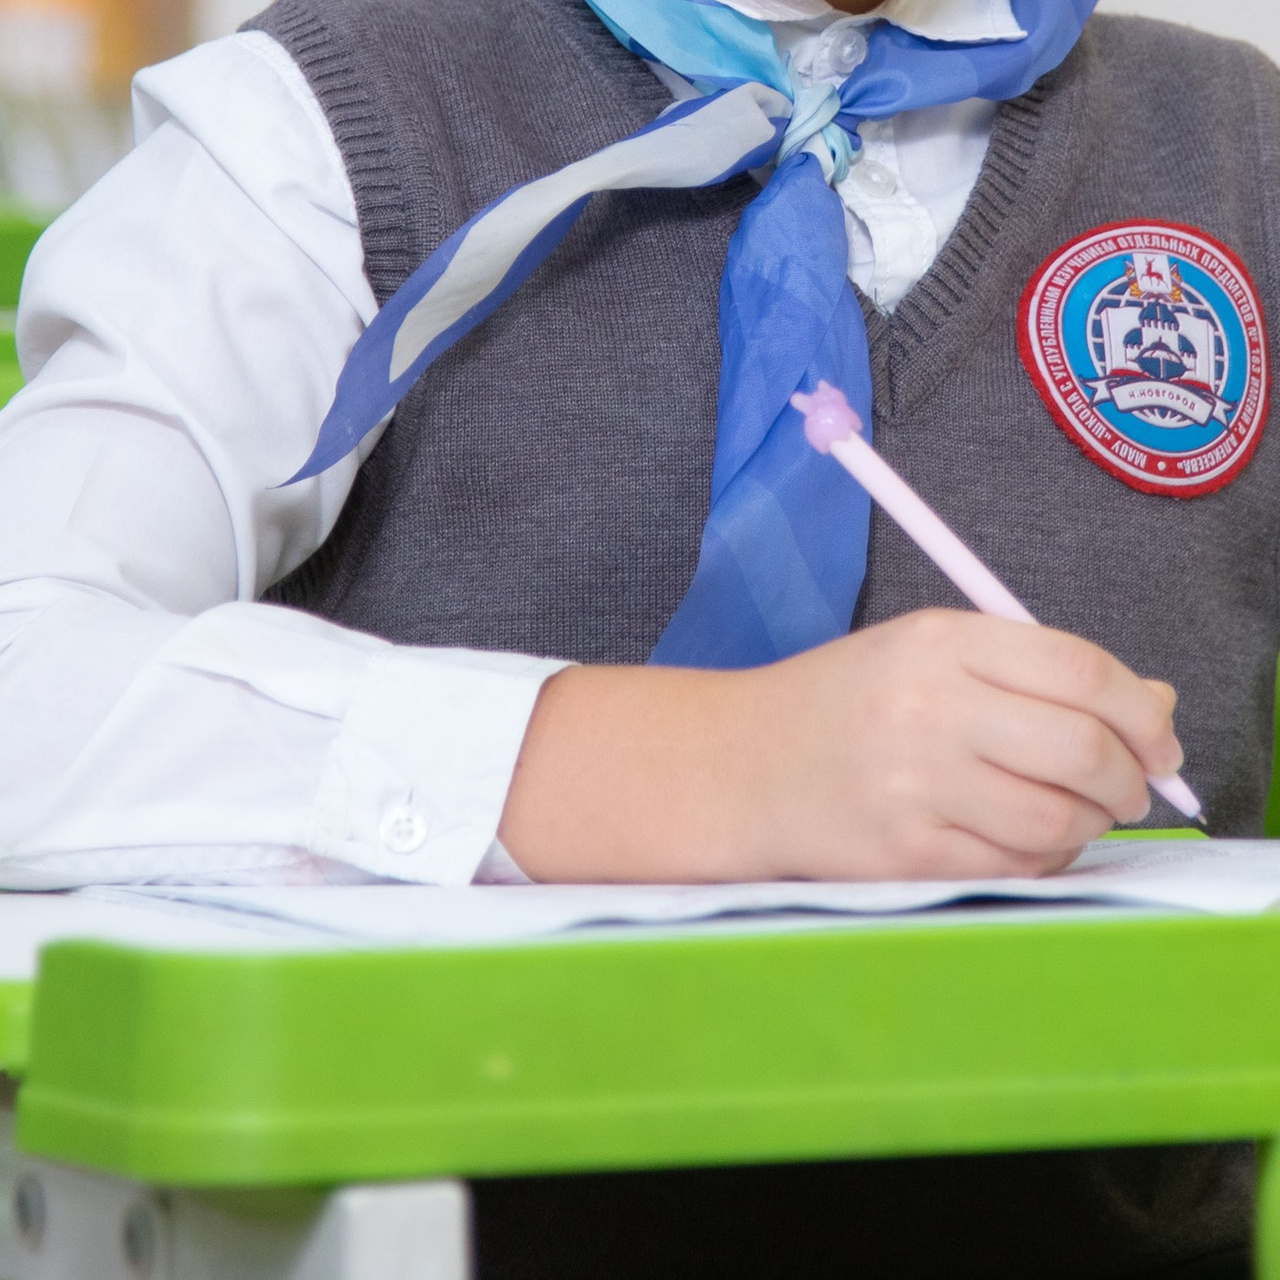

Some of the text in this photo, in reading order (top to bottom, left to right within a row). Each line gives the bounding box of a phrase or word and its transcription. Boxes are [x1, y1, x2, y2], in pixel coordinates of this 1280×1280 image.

[1052, 240, 1117, 286] ИЗУЧЕНИЕМ
[1117, 233, 1201, 261] ОТДЕЛЬНЫХ
[1200, 252, 1254, 322] ПРЕДМЕТОВ
[1039, 286, 1067, 381] УГЛУБЛЕННЫМ
[1251, 348, 1261, 374] 183
[1059, 381, 1073, 392] С
[1240, 376, 1261, 425] ИМЕНИ
[1066, 391, 1112, 441] «ШКОЛА
[1111, 441, 1148, 469] МАОУ
